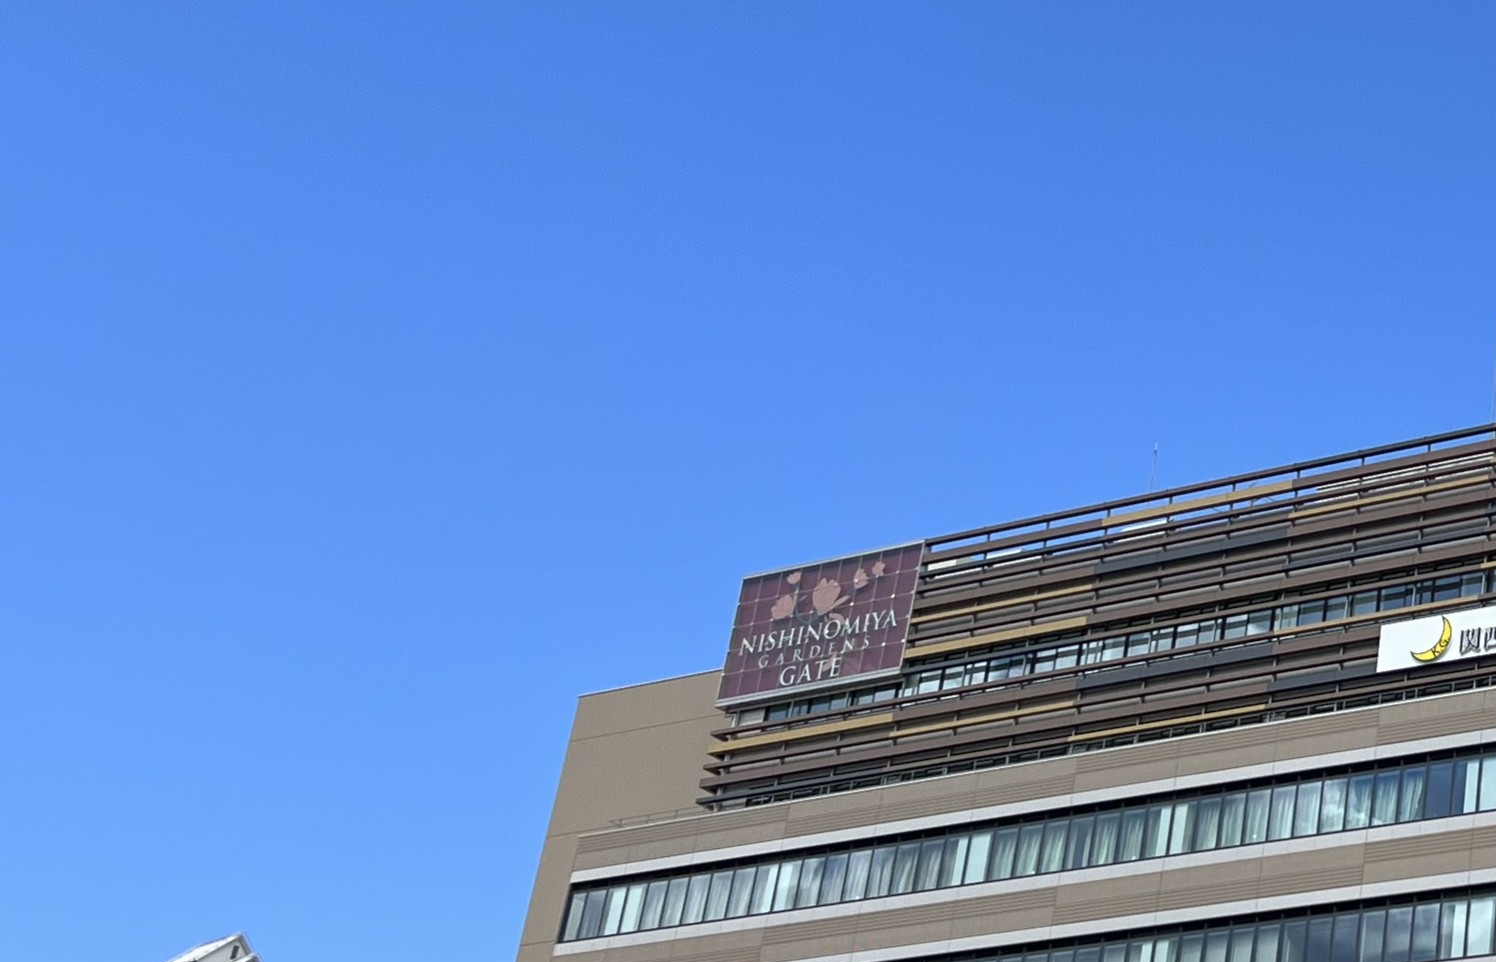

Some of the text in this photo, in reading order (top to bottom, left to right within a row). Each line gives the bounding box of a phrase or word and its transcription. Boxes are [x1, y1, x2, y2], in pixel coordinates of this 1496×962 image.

[739, 609, 897, 656] NISHINOMIYA
[758, 635, 871, 668] GARDENS
[780, 657, 843, 686] GATE
